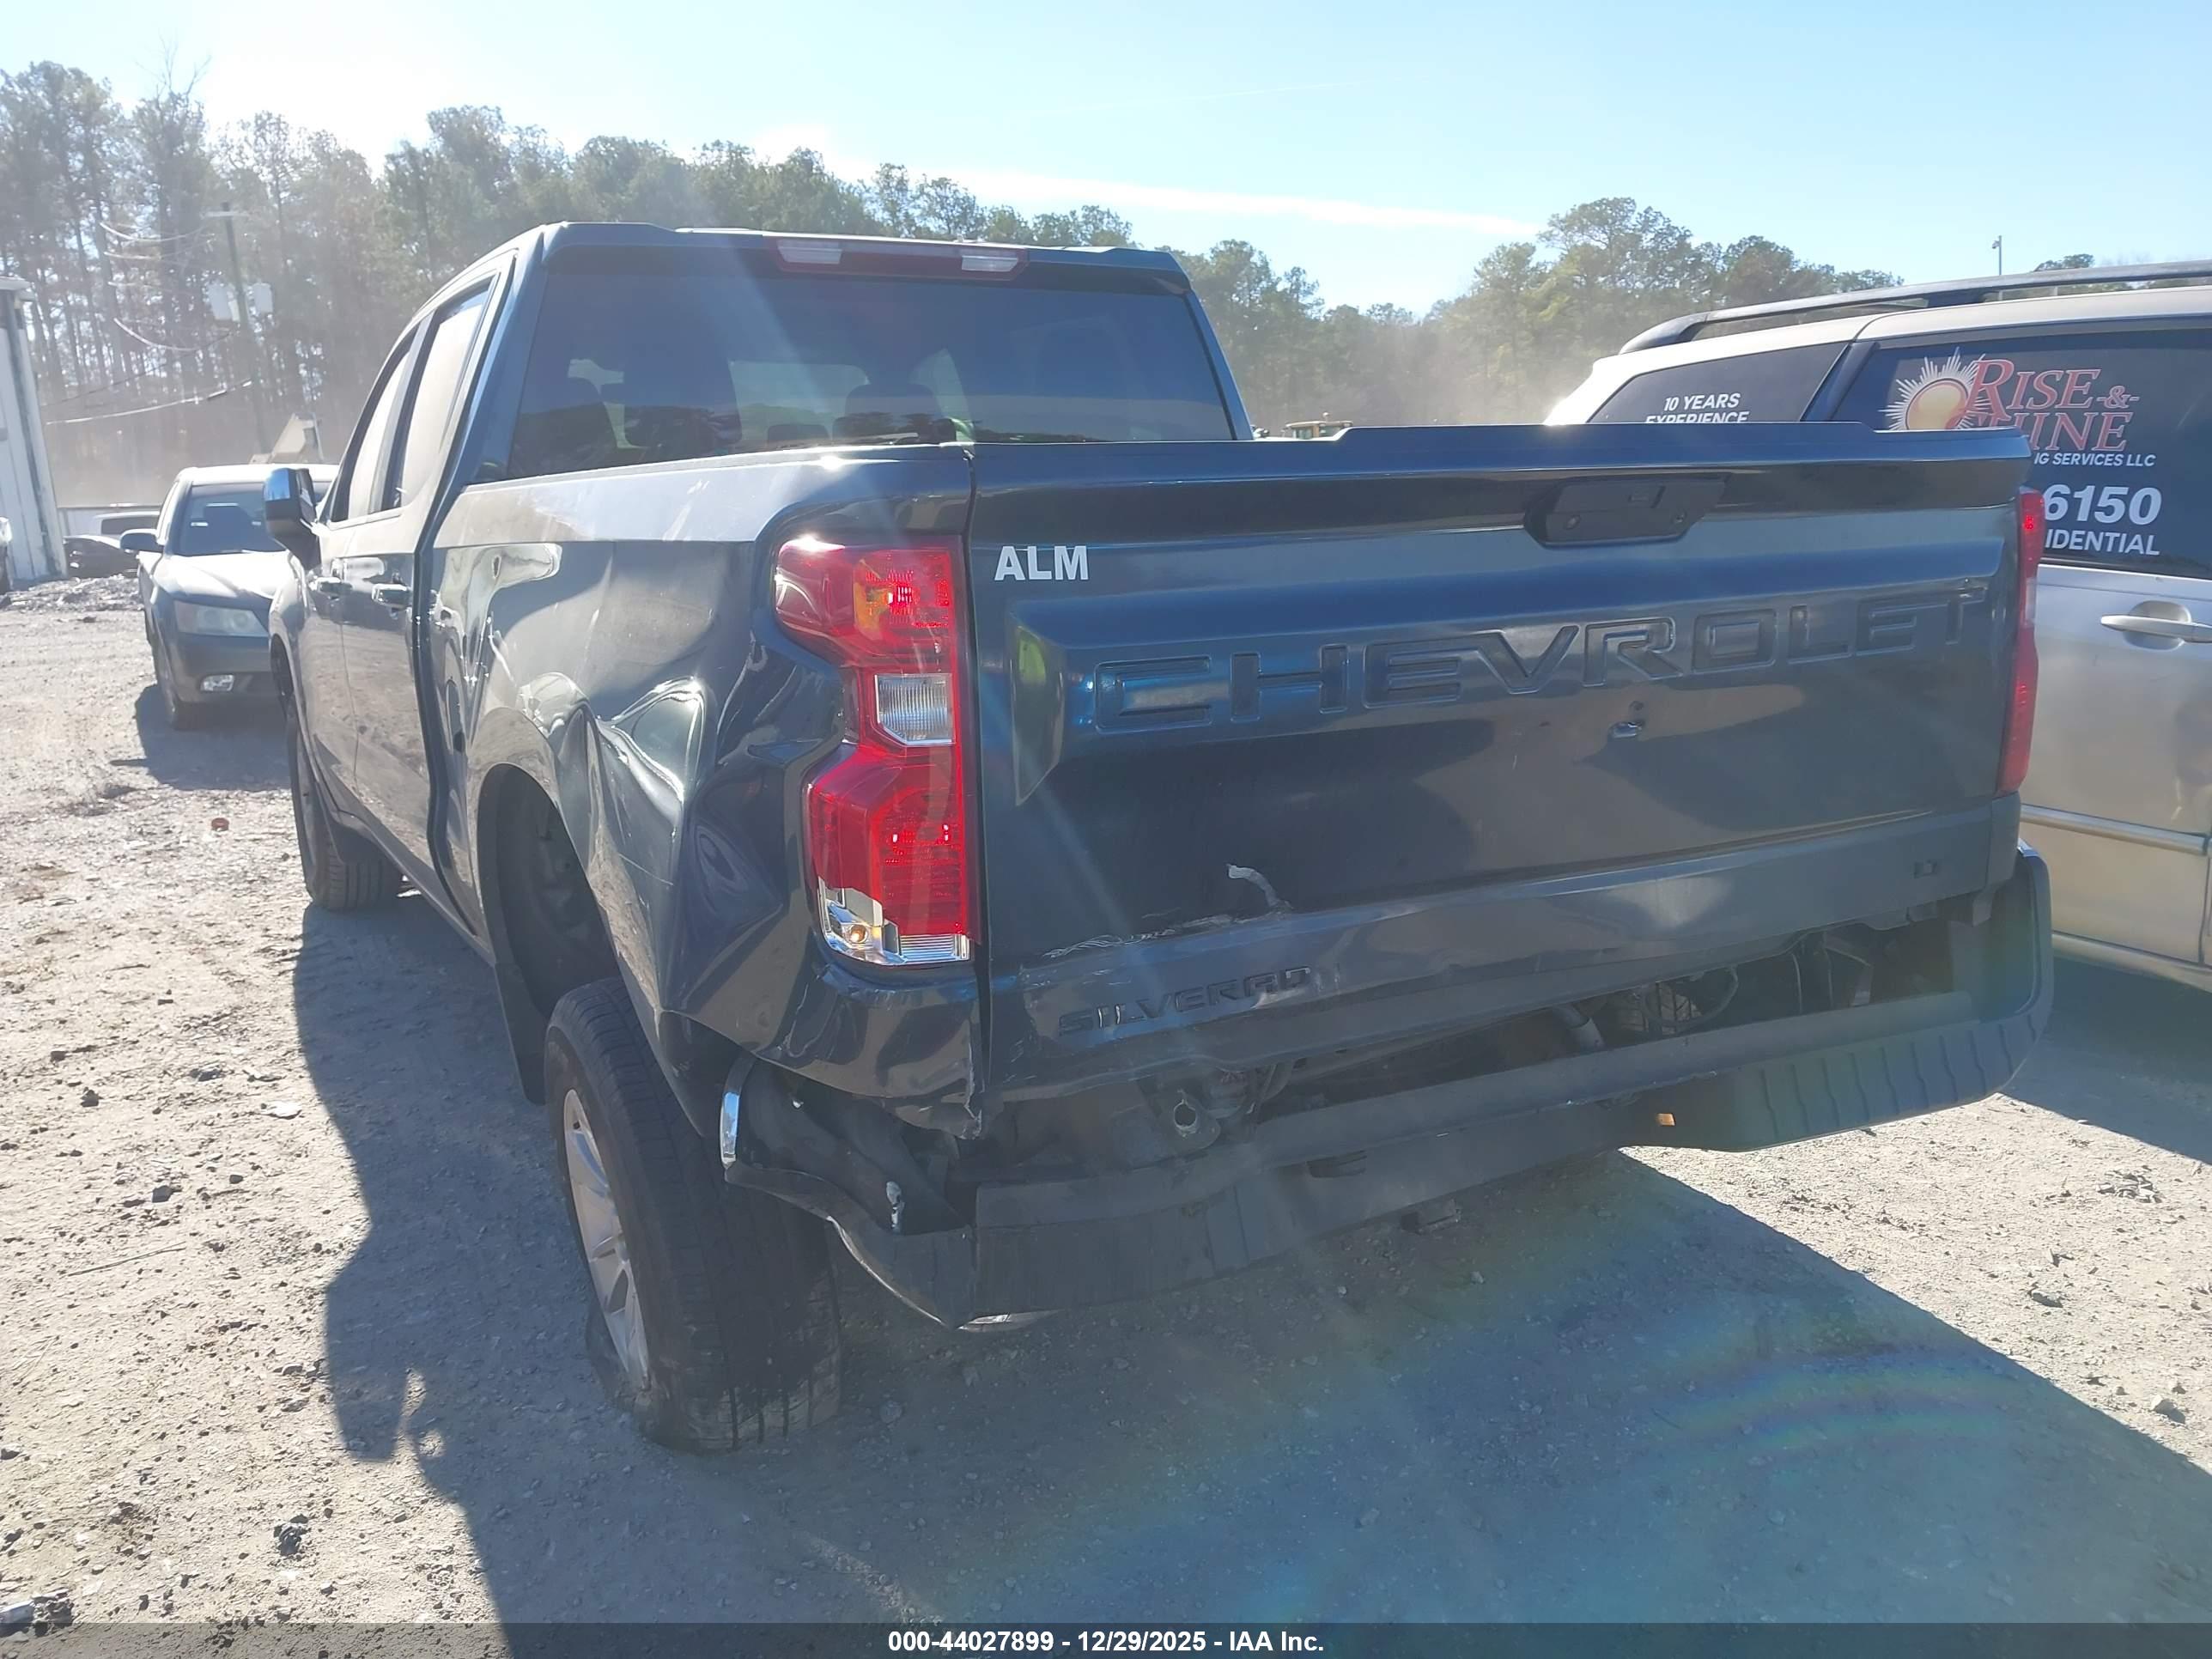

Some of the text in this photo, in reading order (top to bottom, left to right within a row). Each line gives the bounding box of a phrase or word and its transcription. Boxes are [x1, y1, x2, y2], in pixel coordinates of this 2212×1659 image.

[1663, 392, 1741, 411] 10 YEARS
[1962, 358, 2102, 421] RISE
[1645, 411, 1750, 423] EXPERIENCE
[2052, 453, 2124, 466] SERVICES
[2126, 453, 2156, 466] LLC
[2043, 483, 2162, 526] 6150
[994, 545, 1089, 580] ALM
[1095, 587, 1988, 734] CHEVROLET
[1058, 963, 1340, 1036] SILVERAD
